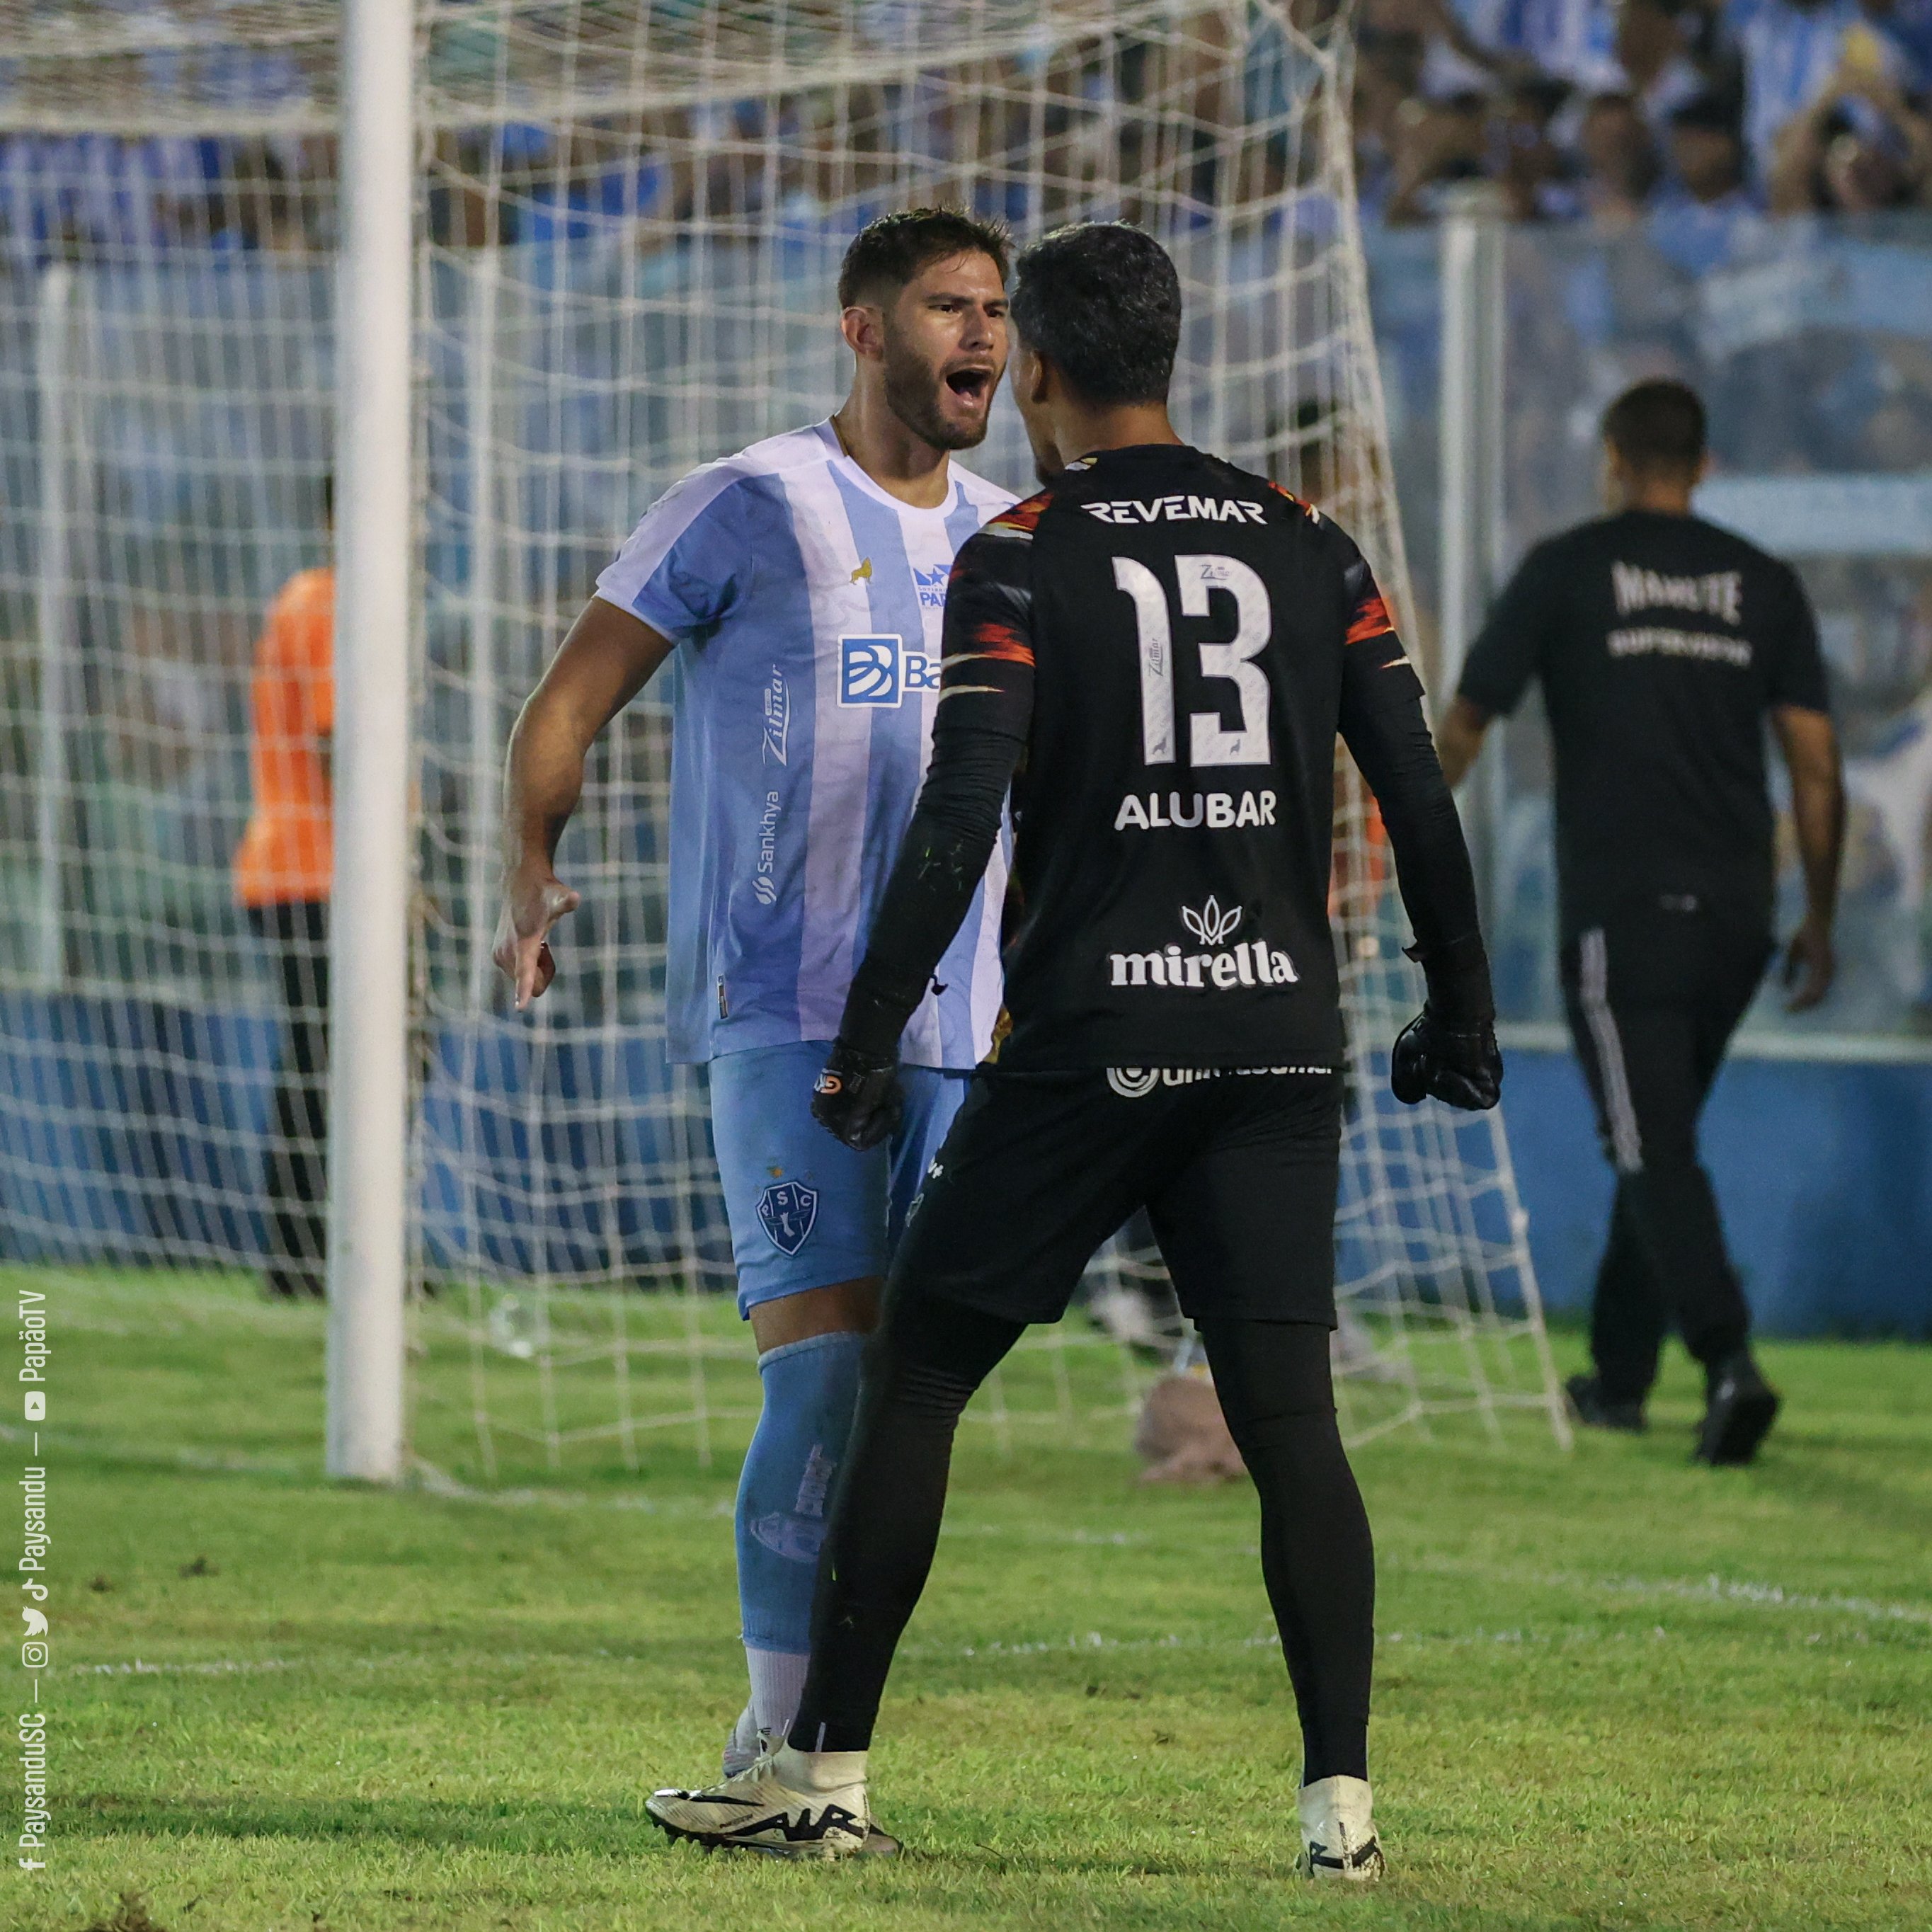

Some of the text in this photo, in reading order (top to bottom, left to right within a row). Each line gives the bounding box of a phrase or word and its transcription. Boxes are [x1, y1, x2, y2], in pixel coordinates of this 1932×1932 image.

[1080, 496, 1269, 525] REVEMAR
[1111, 554, 1273, 767] 13
[762, 663, 790, 767] Zilmar
[758, 790, 781, 874] Sankhya
[1114, 789, 1277, 831] ALUBAR
[1109, 939, 1300, 988] mirella
